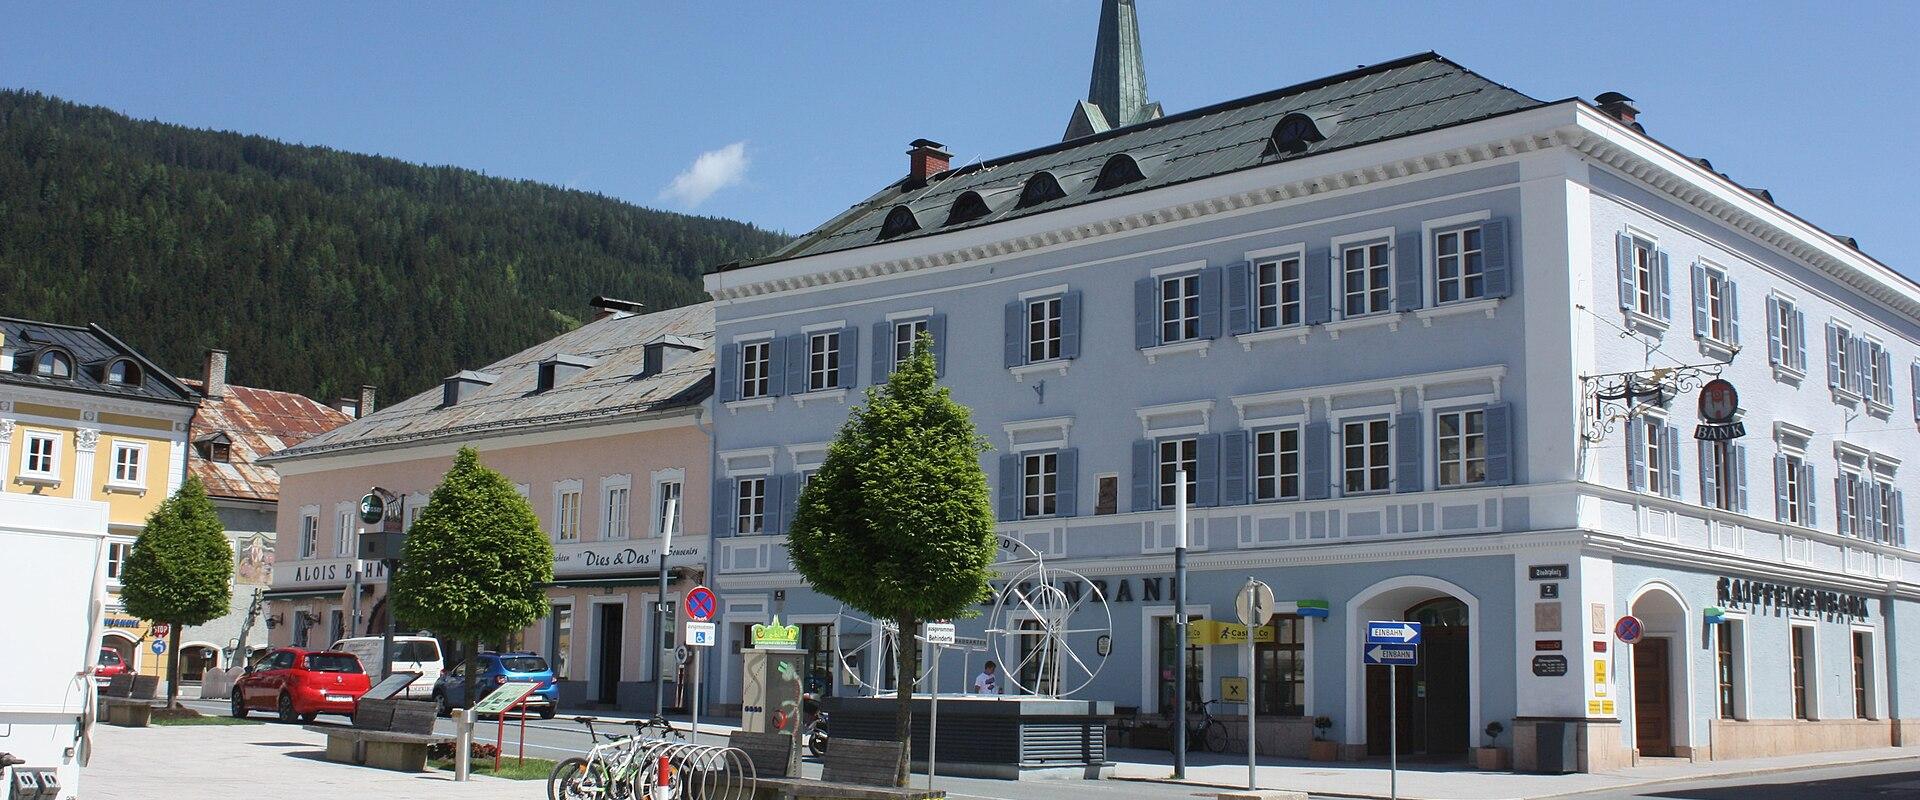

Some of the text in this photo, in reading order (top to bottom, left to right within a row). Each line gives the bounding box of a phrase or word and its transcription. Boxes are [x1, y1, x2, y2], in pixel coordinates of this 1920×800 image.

[1697, 425, 1743, 439] BANK
[613, 552, 624, 565] &
[296, 564, 336, 581] ALOIS
[154, 625, 168, 633] STOP
[1259, 629, 1269, 637] Co
[1382, 650, 1411, 658] EINBAHN
